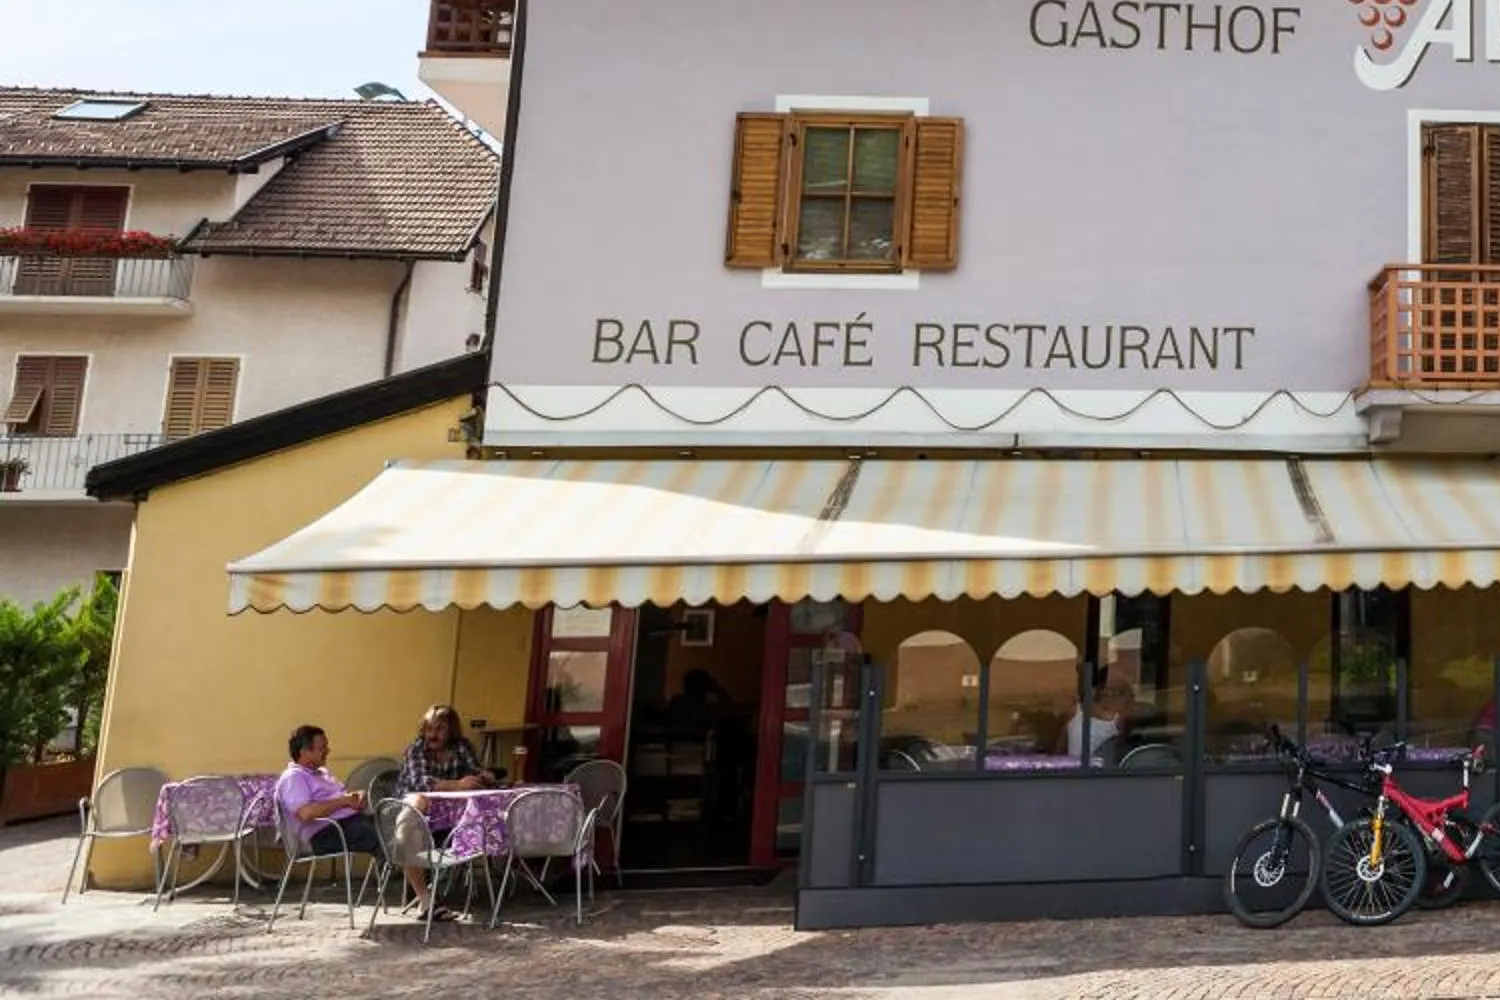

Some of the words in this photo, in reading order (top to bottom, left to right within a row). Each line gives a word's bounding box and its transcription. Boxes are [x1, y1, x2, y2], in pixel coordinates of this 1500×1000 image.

[591, 318, 702, 365] BAR
[738, 311, 875, 367] CAFÉ
[911, 322, 1256, 370] RESTAURANT
